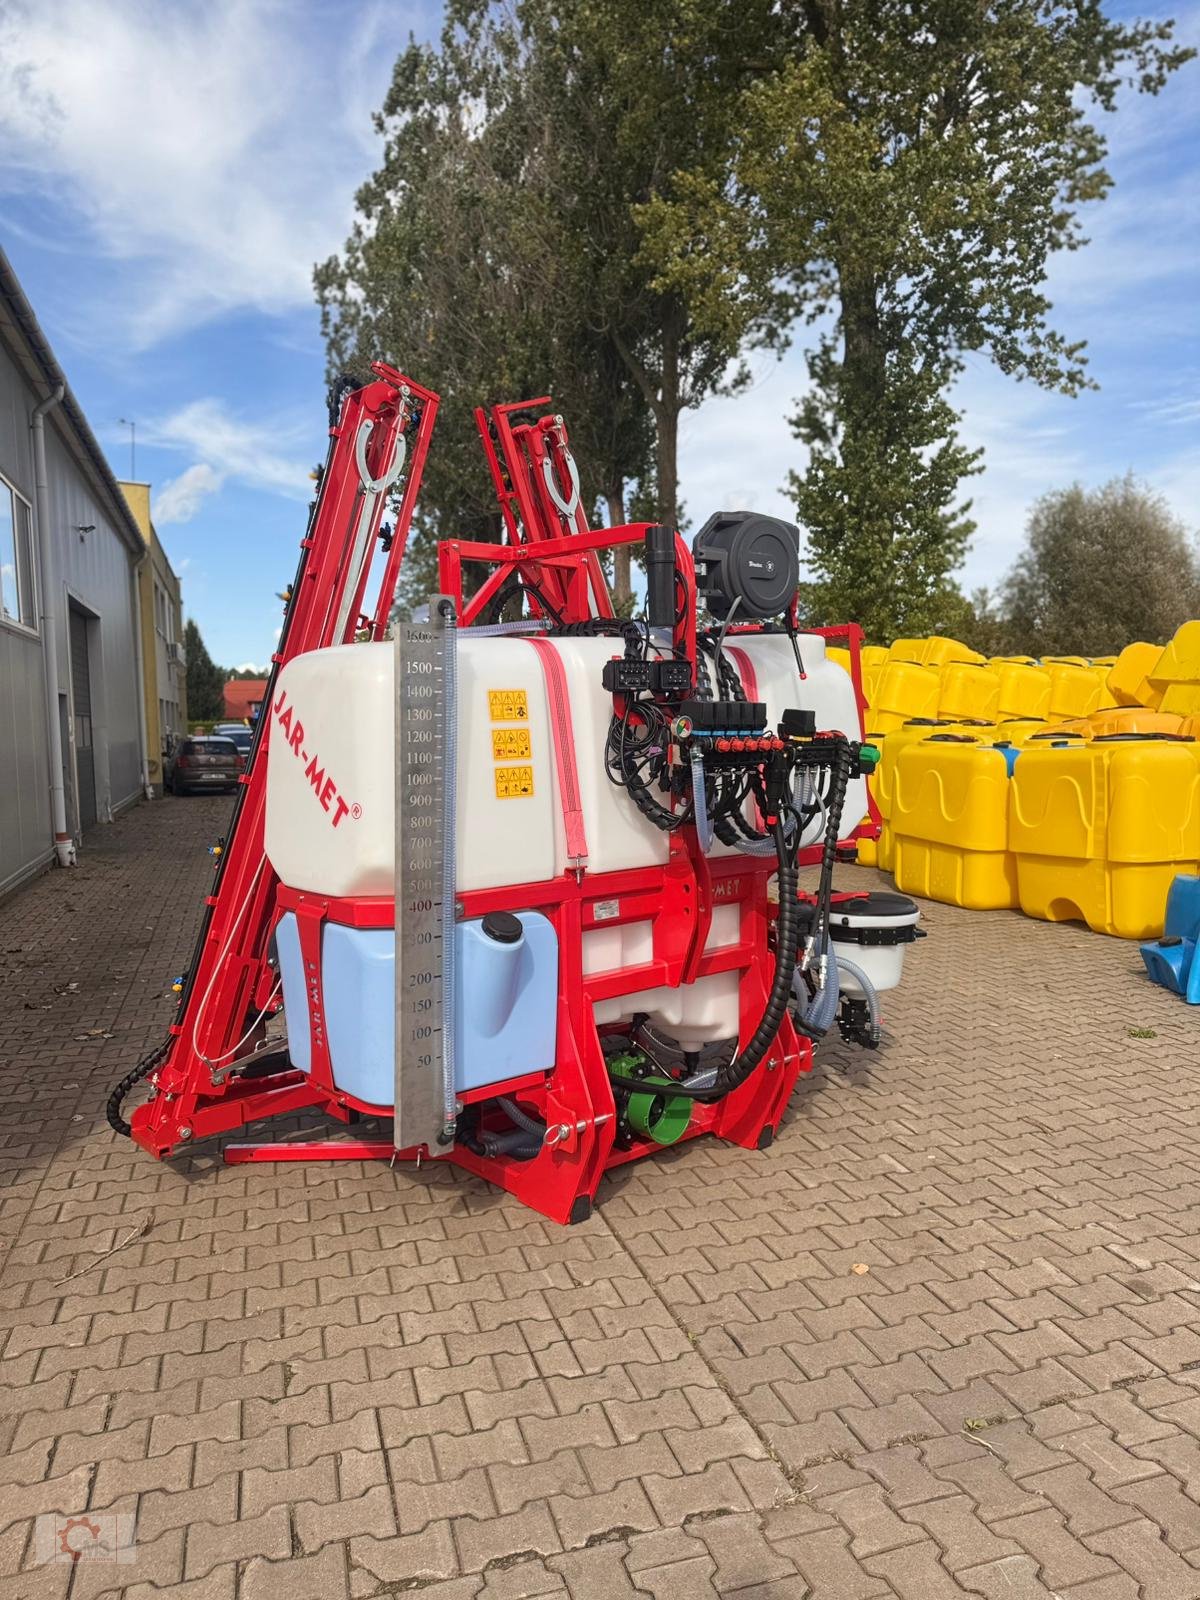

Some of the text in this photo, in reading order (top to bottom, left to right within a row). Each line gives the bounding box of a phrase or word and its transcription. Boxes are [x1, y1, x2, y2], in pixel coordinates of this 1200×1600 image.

[407, 662, 432, 674] 1500
[407, 685, 432, 697] 1400
[407, 709, 432, 721] 1300
[407, 731, 432, 743] 1200
[274, 690, 349, 828] JAR-MET
[407, 752, 432, 764] 1100
[407, 774, 432, 786] 1000
[409, 795, 432, 807] 900
[410, 816, 432, 828] 800
[410, 837, 432, 849] 700
[409, 857, 432, 870] 600
[409, 879, 432, 891] 500
[409, 900, 432, 912] 400
[409, 972, 432, 987] 200
[412, 998, 432, 1013] 150
[411, 1026, 432, 1041] 100
[417, 1054, 432, 1068] 50
